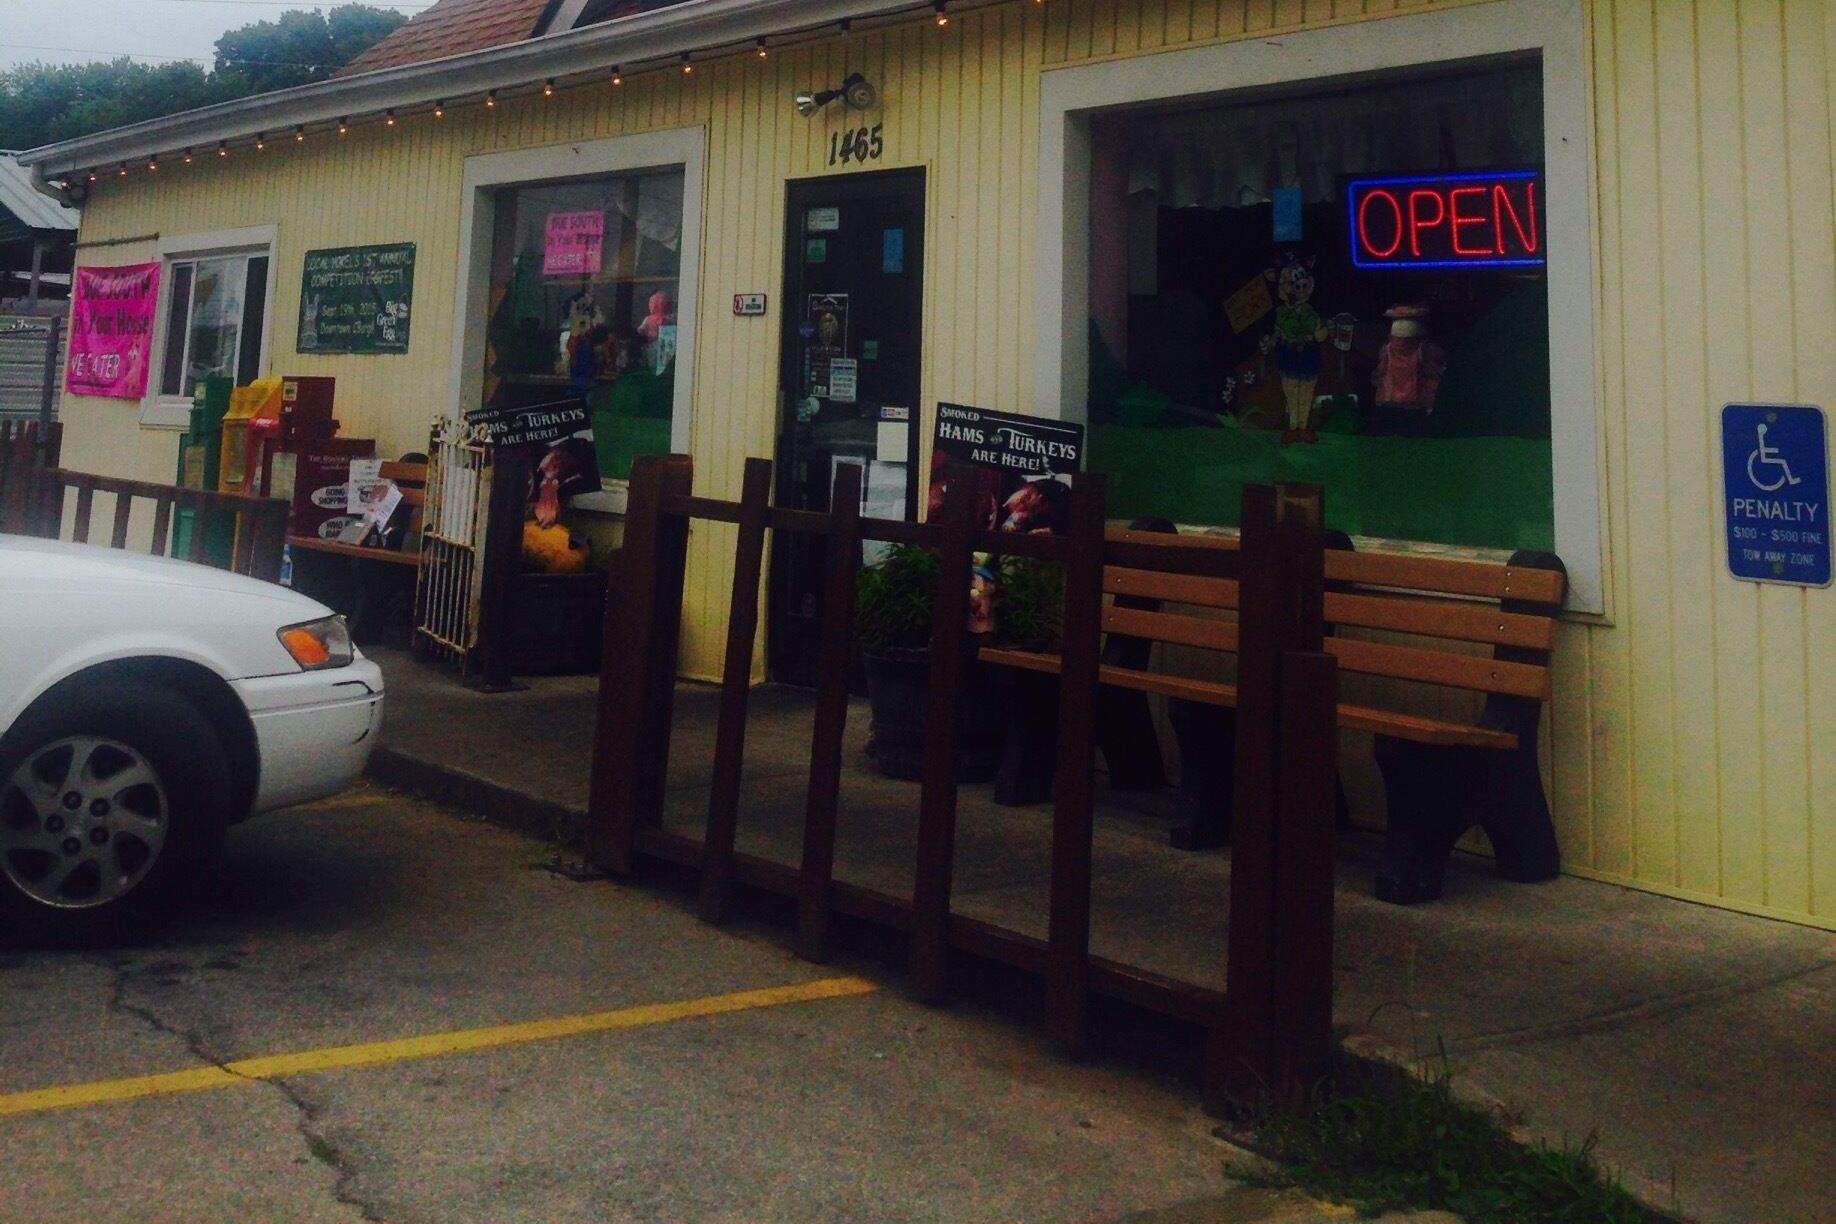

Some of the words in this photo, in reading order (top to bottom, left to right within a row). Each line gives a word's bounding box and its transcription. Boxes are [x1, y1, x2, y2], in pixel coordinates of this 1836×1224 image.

[829, 122, 883, 166] 1465
[1358, 181, 1537, 257] OPEN
[516, 408, 585, 428] TURKEYS
[940, 406, 980, 422] SMOKED
[501, 434, 523, 445] ARE
[525, 427, 559, 442] HERE!
[939, 422, 984, 444] HAMS
[998, 427, 1077, 460] TURKEYS
[971, 448, 997, 463] ARE
[1001, 452, 1040, 470] HERE!
[1733, 498, 1818, 522] PENALTY
[1802, 531, 1823, 545] FINE
[1743, 548, 1760, 561] TOW
[1764, 550, 1786, 564] AWAY
[1790, 552, 1815, 567] ZONE
